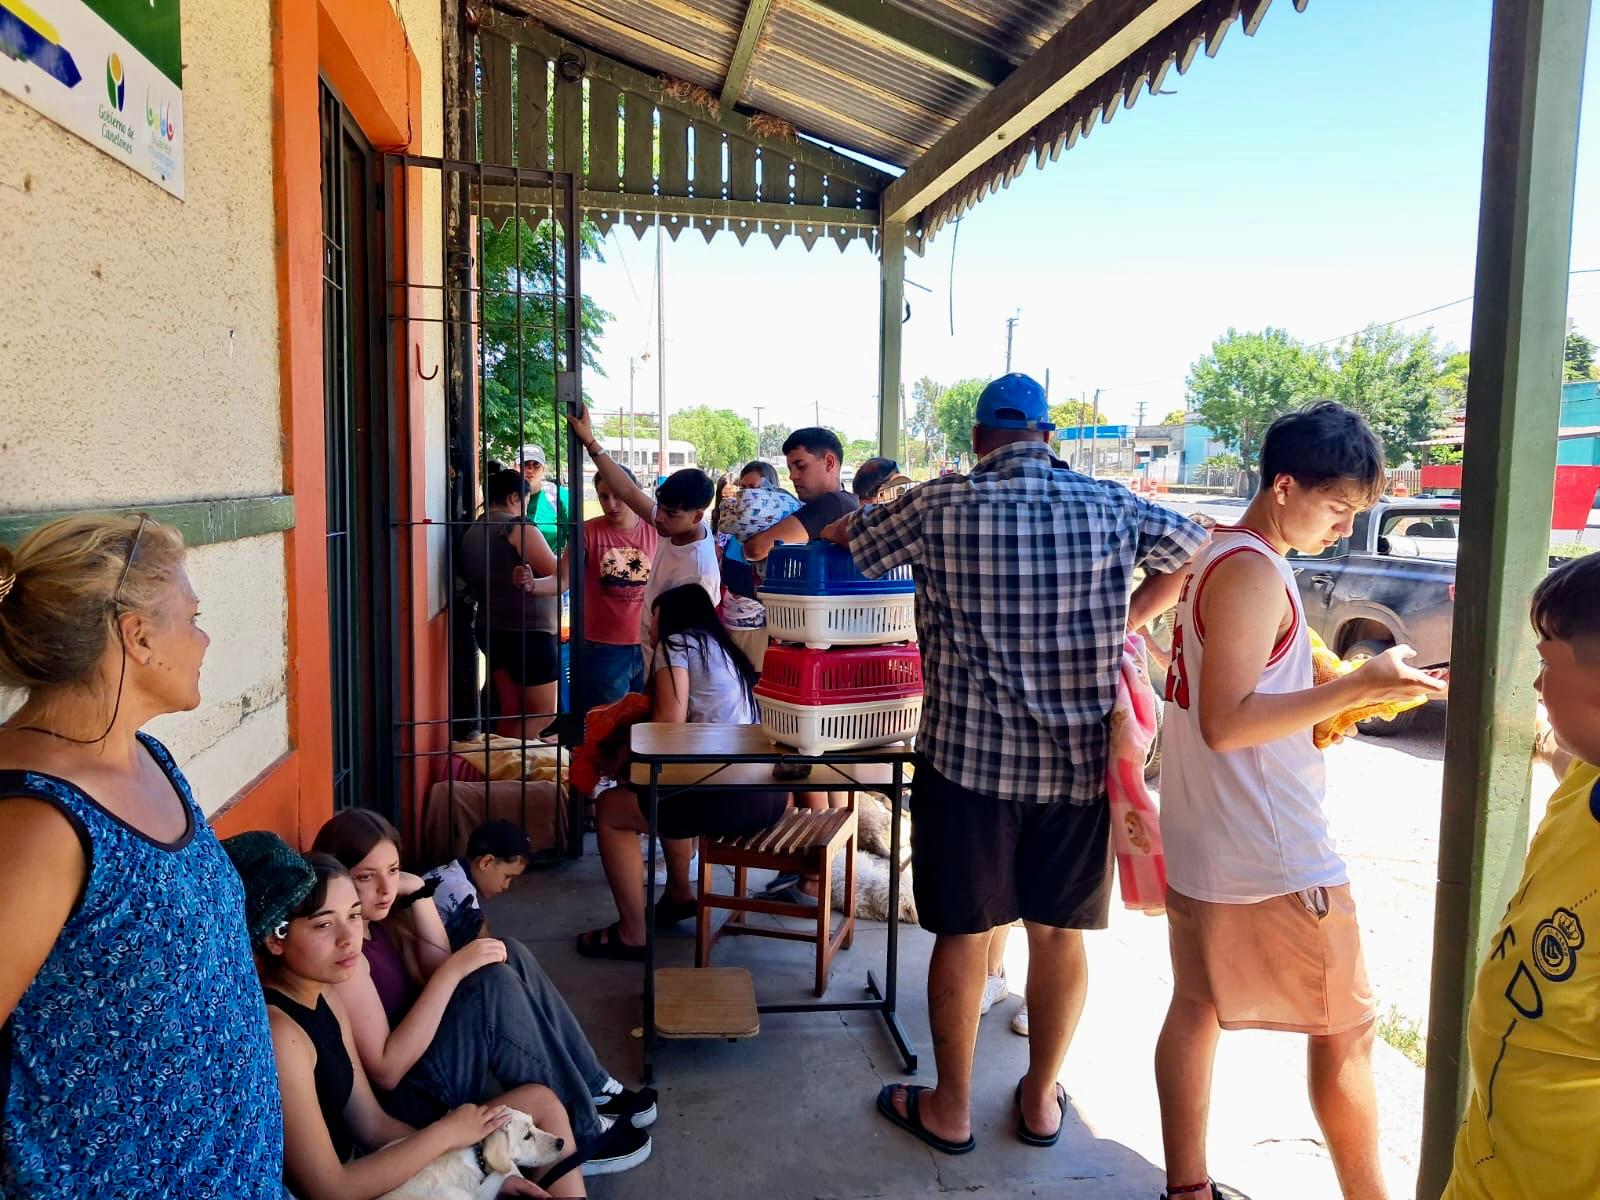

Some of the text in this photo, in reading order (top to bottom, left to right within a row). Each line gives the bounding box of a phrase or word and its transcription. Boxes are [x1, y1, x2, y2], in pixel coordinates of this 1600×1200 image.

[99, 104, 134, 140] Gobierno de
[102, 122, 133, 154] Canelones
